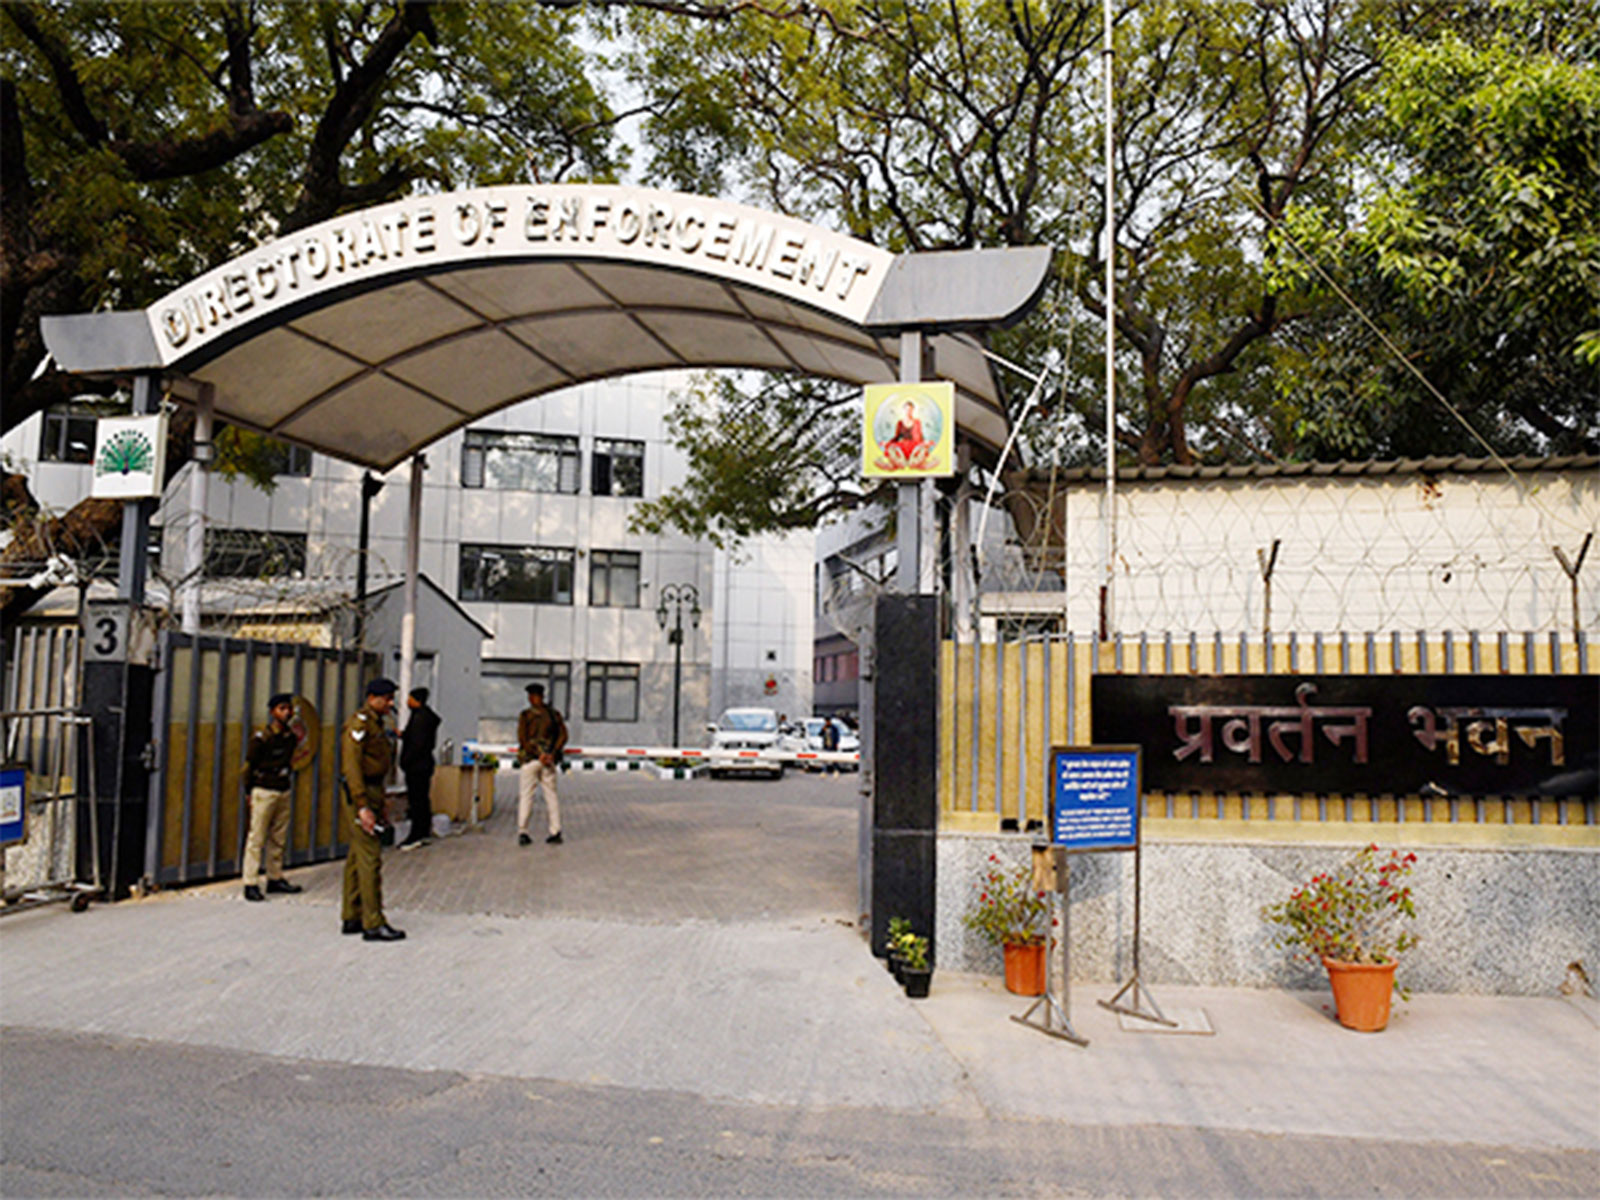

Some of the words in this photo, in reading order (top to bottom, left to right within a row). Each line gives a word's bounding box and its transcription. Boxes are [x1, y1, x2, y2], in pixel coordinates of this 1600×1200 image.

[161, 207, 437, 348] DIRECTORATE
[453, 201, 508, 246] OF
[526, 196, 870, 301] ENFORCEMENT
[94, 618, 118, 656] 3
[1168, 682, 1372, 763] प्रवर्तन
[1407, 705, 1568, 766] भवन
